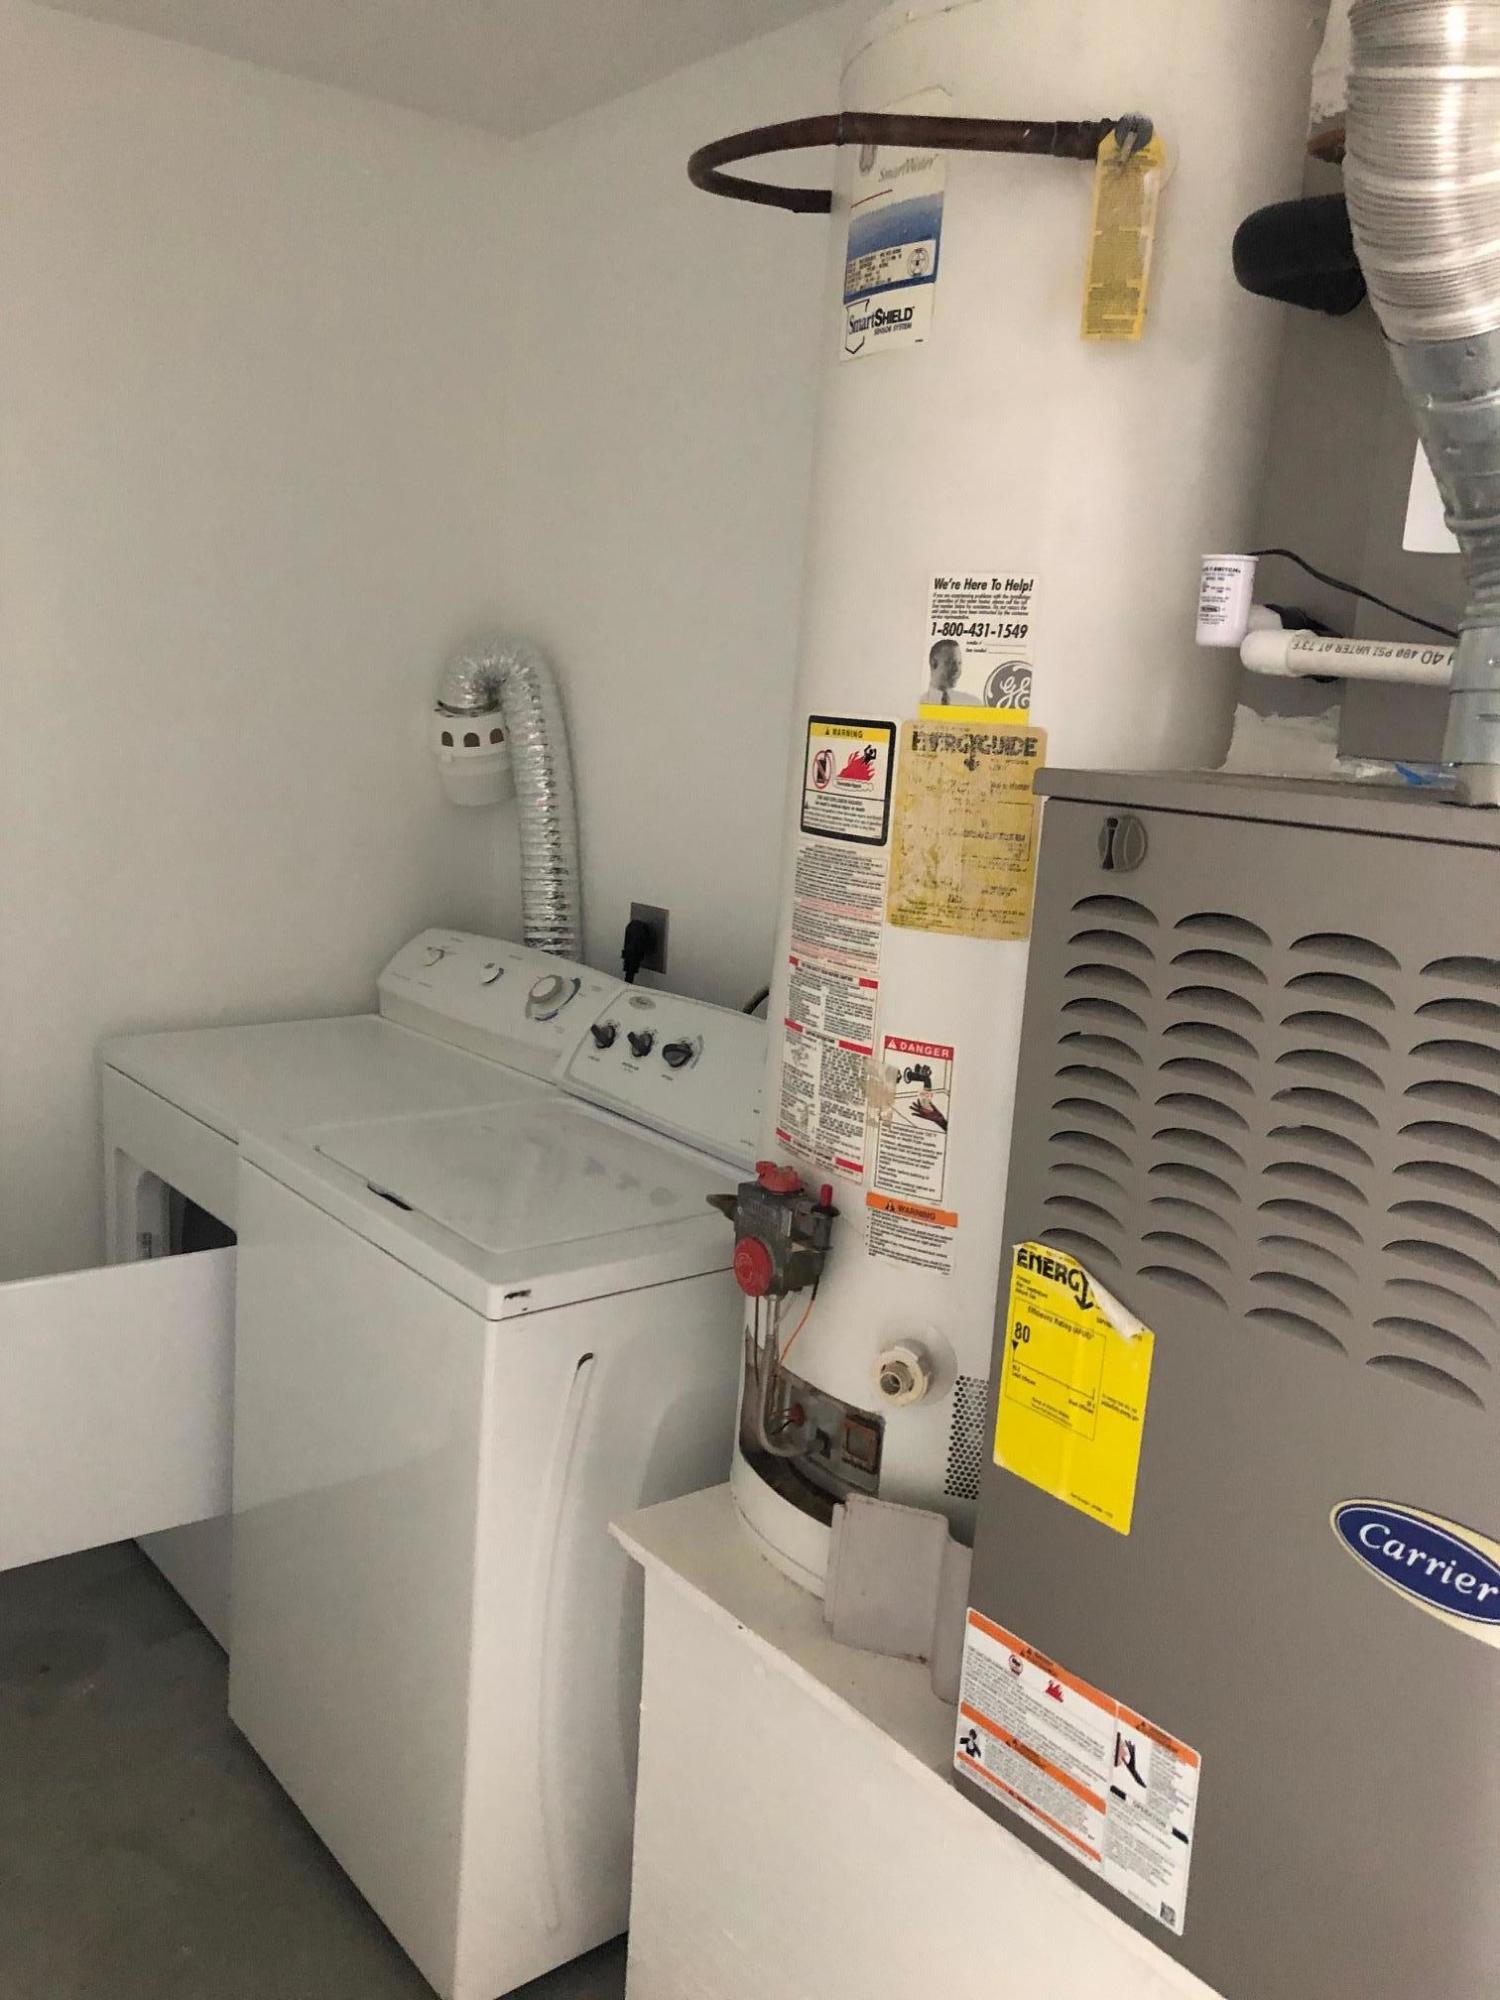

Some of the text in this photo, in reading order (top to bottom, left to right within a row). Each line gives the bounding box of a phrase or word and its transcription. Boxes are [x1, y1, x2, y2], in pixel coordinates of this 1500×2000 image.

[934, 578, 1034, 594] We're Here To Help!
[931, 622, 1029, 639] 1-800-431-1549
[1317, 642, 1334, 653] AT
[1335, 643, 1371, 656] WATER
[1372, 645, 1394, 658] PSI
[1420, 650, 1444, 665] 40
[832, 729, 863, 739] WARNING
[900, 1042, 950, 1058] DANGER
[897, 1203, 937, 1221] WARNING
[1014, 1321, 1031, 1343] 80
[1359, 1523, 1499, 1602] Carrier
